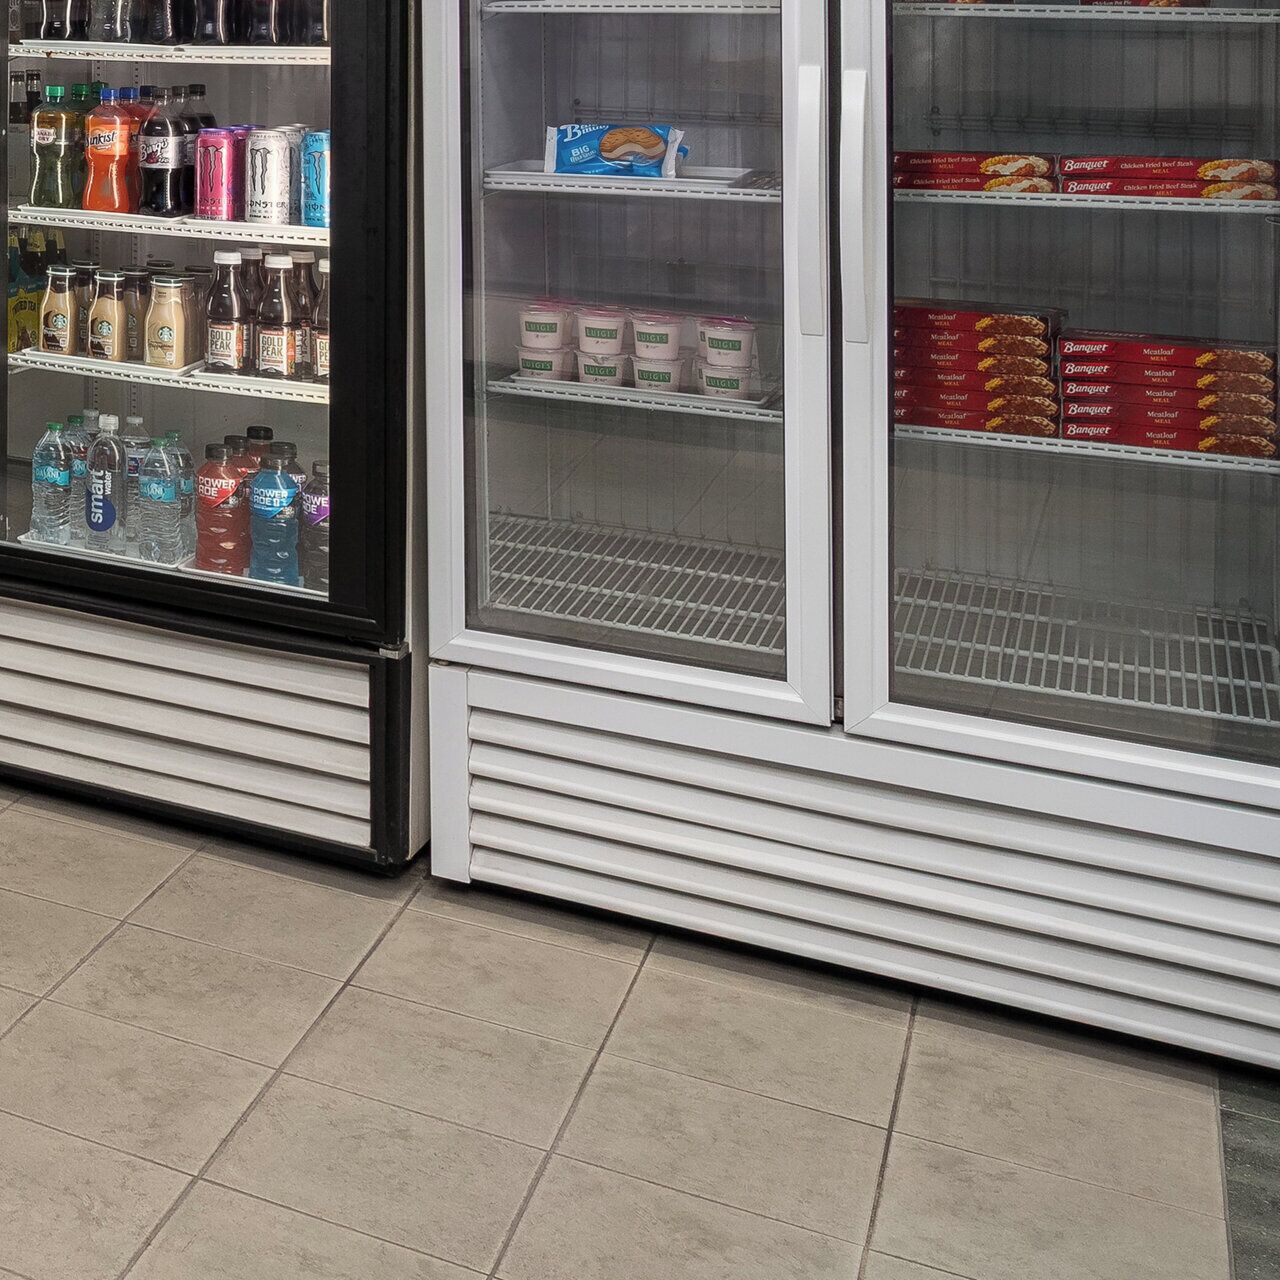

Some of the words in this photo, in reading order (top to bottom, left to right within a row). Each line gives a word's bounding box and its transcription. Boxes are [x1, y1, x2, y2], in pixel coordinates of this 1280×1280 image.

[571, 145, 590, 157] BIG
[210, 330, 232, 341] GOLD
[210, 339, 231, 351] PEAK
[261, 336, 283, 348] GOLD
[261, 346, 283, 357] PEAK
[585, 366, 616, 376] LUIGI'S
[639, 371, 671, 381] LUIGI'S
[706, 378, 739, 388] LUIGI'S
[1068, 403, 1114, 416] Banquet
[1147, 411, 1179, 419] Meatloaf
[1066, 424, 1113, 436] Banquet
[1145, 432, 1177, 440] Meatloaf
[104, 471, 112, 496] water
[198, 476, 236, 489] POWER
[90, 470, 104, 524] smart
[253, 487, 288, 499] POWER
